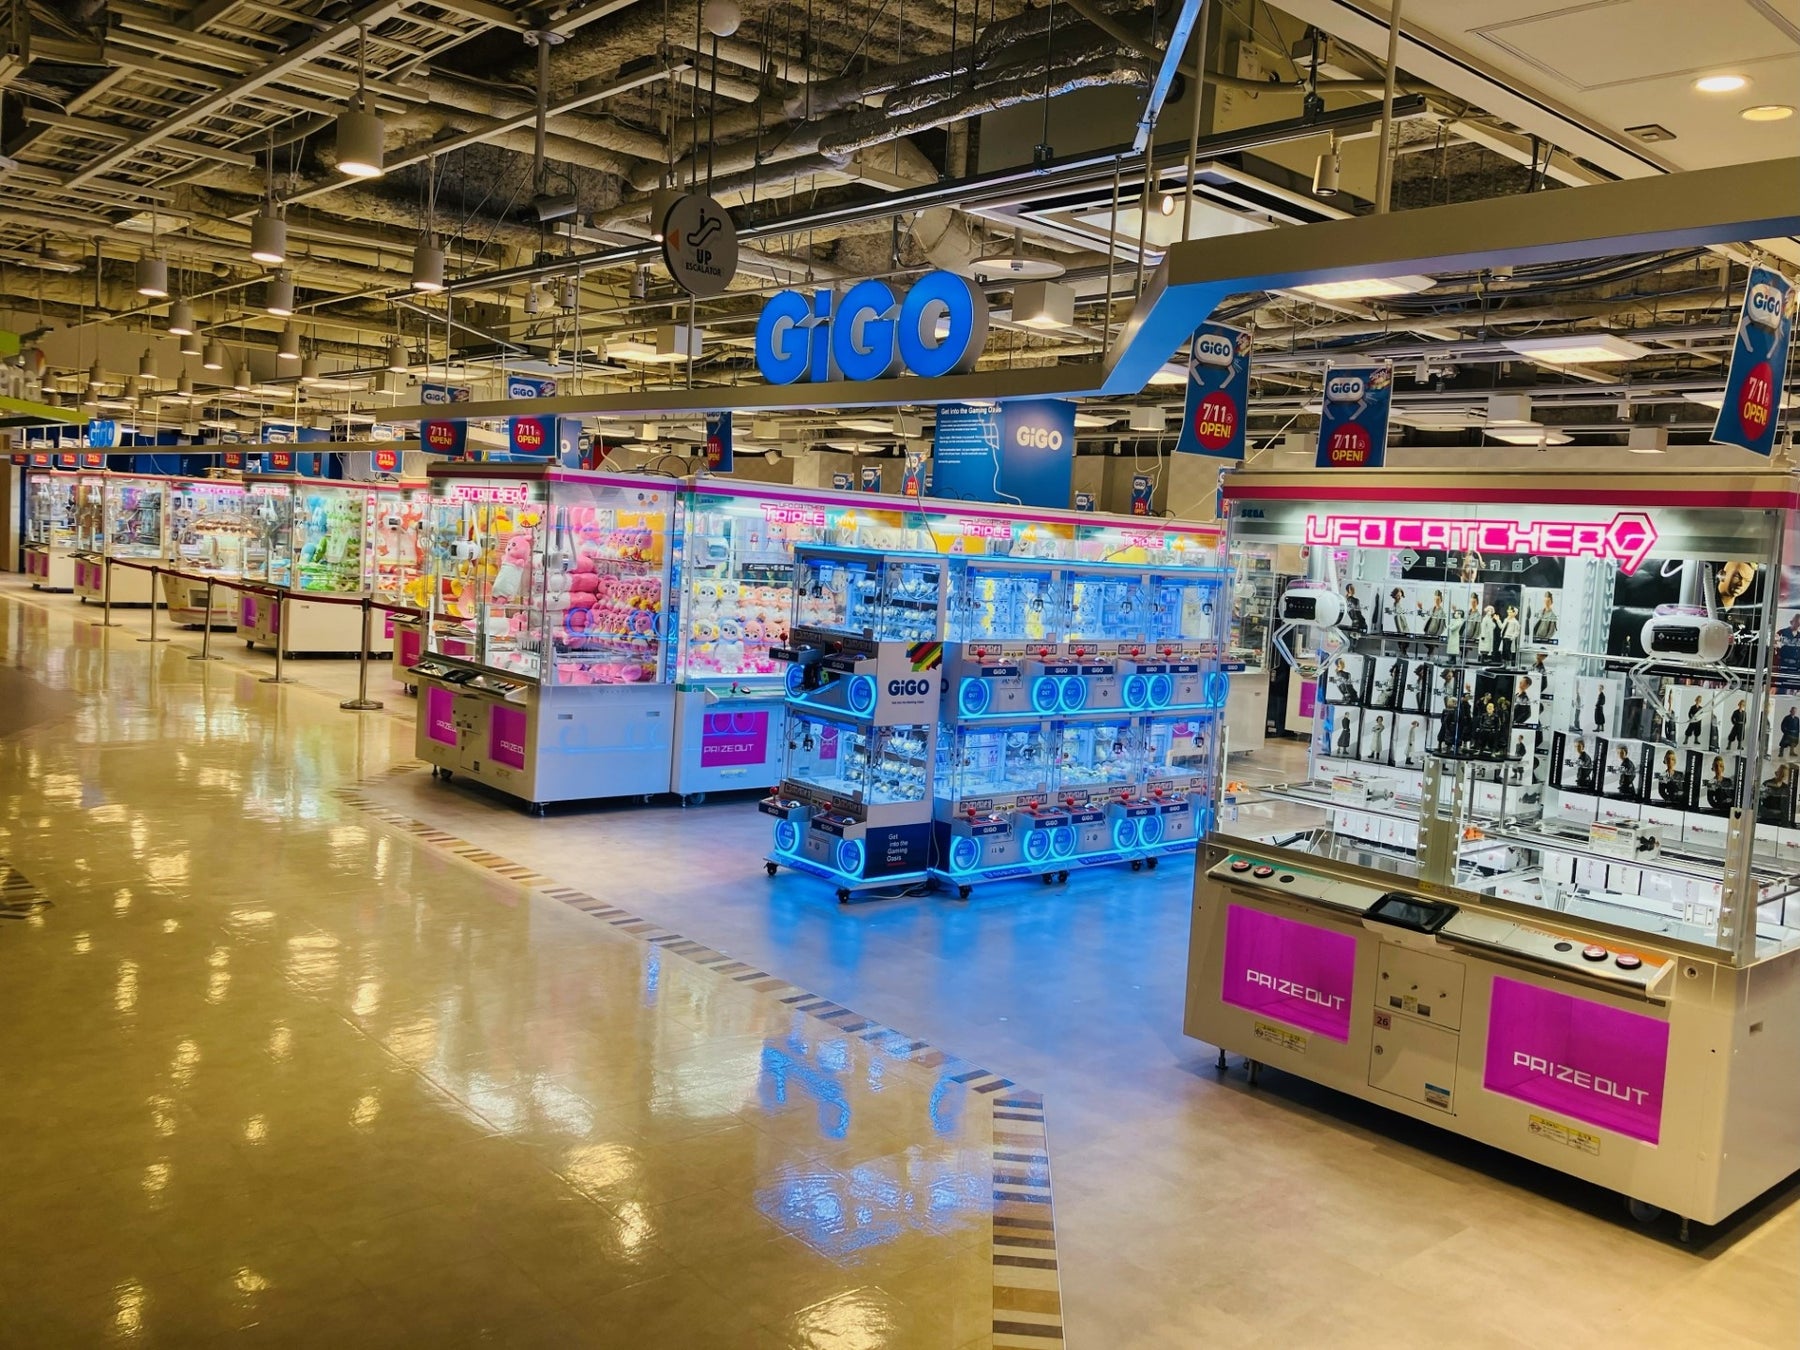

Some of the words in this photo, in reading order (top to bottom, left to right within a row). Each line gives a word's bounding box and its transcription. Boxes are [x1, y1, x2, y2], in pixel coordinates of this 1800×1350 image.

[696, 248, 712, 266] UP
[685, 262, 721, 277] ESCALATOR
[1753, 291, 1781, 317] GiGO
[755, 270, 975, 386] GiGO
[1200, 340, 1231, 357] GiGO
[512, 387, 534, 398] GiGO
[1331, 382, 1360, 394] GiGO
[1743, 401, 1769, 425] OPEN!
[1016, 425, 1063, 450] GiGO
[1199, 420, 1232, 438] OPEN!
[429, 435, 453, 445] OPEN!
[517, 434, 541, 445] OPEN!
[1332, 449, 1364, 462] OPEN!
[760, 503, 825, 527] TRIPLE
[960, 519, 1012, 539] TRIPLE
[1305, 514, 1387, 548] UFO
[888, 679, 930, 696] GiGO
[1376, 1015, 1389, 1027] 26
